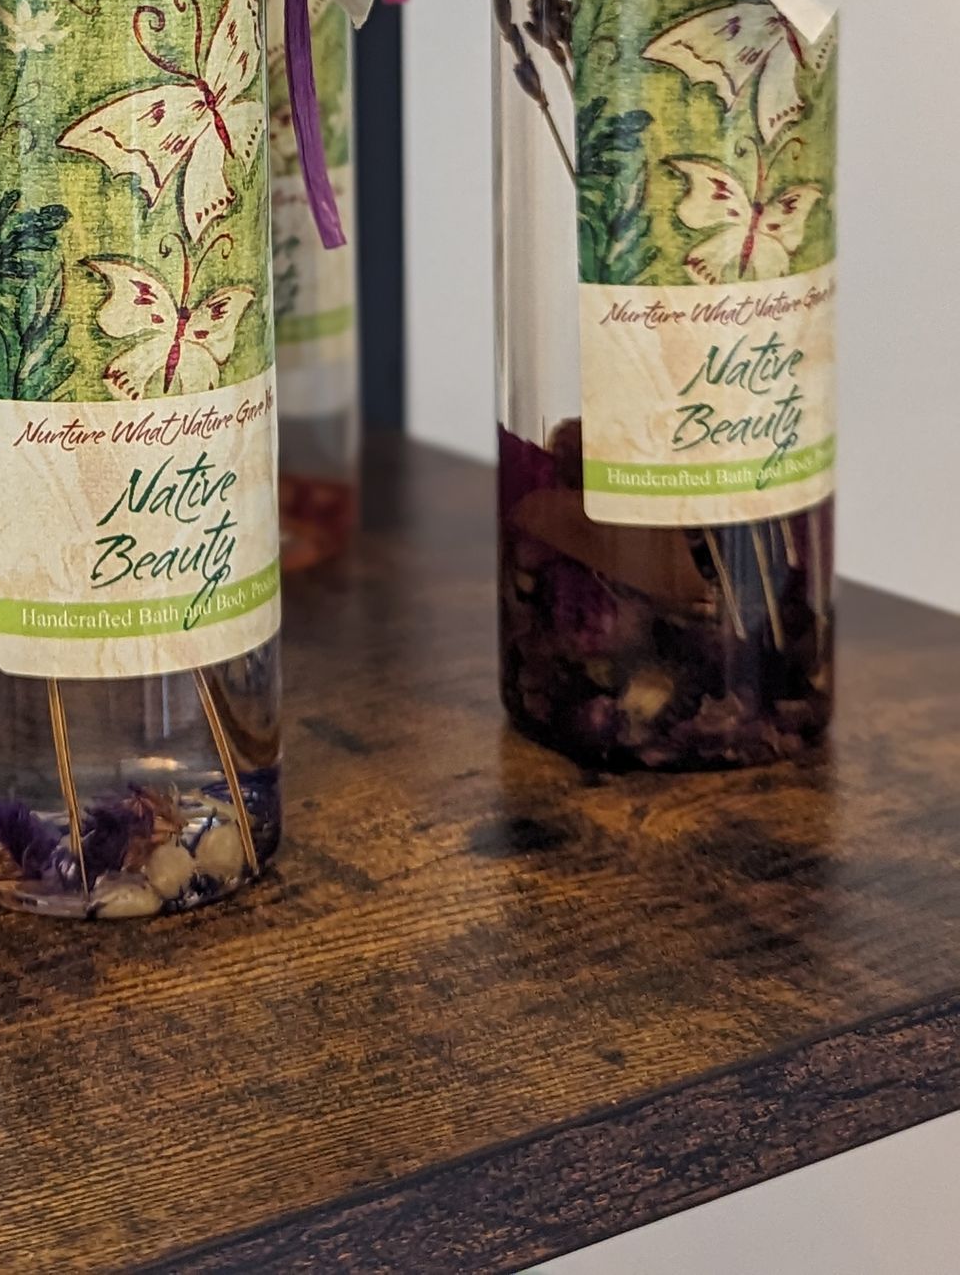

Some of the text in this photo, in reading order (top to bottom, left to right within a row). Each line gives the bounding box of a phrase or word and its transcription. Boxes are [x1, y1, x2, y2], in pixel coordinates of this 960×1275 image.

[600, 299, 686, 329] Nurture
[690, 295, 753, 326] What
[752, 291, 802, 322] Nature
[677, 331, 804, 396] Native
[13, 418, 106, 451] Nurture
[111, 412, 182, 446] What
[179, 405, 233, 439] Nature
[672, 384, 804, 491] Beauty
[96, 451, 237, 526] Native
[608, 466, 710, 487] Handcrafted
[716, 466, 753, 485] Bath
[90, 510, 237, 630] Beauty
[21, 607, 132, 628] Handcrafted
[139, 603, 179, 626] Bath
[216, 587, 247, 612] Body
